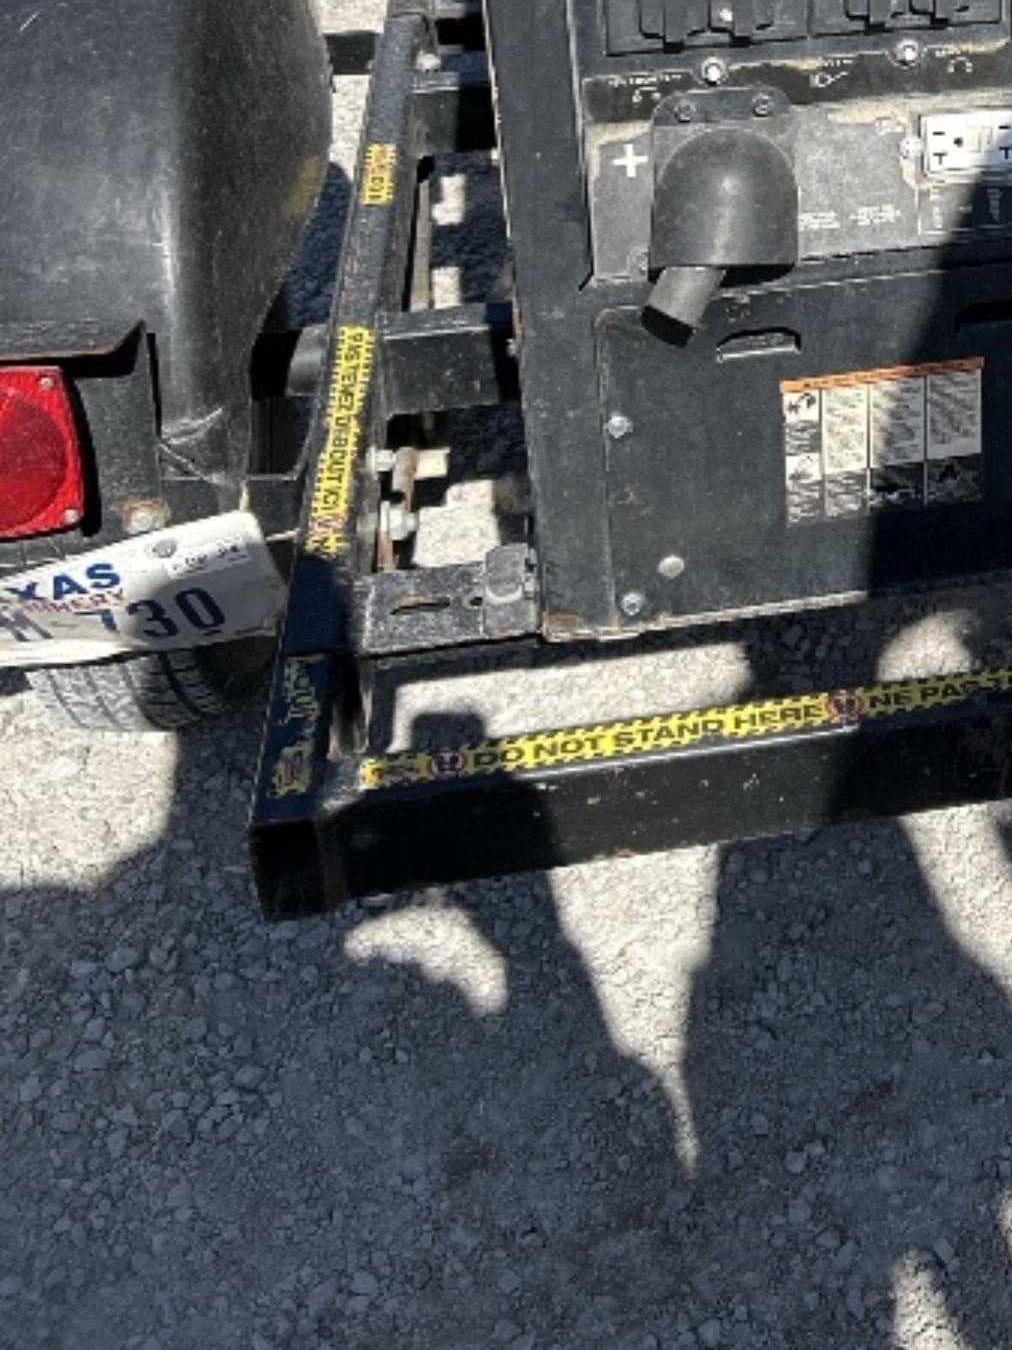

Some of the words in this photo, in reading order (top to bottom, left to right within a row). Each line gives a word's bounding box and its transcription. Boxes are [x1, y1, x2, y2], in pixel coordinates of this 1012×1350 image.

[869, 692, 911, 709] NE
[474, 746, 524, 767] DO
[536, 734, 602, 760] NOT
[612, 717, 724, 748] STAND
[734, 703, 824, 730] HERE
